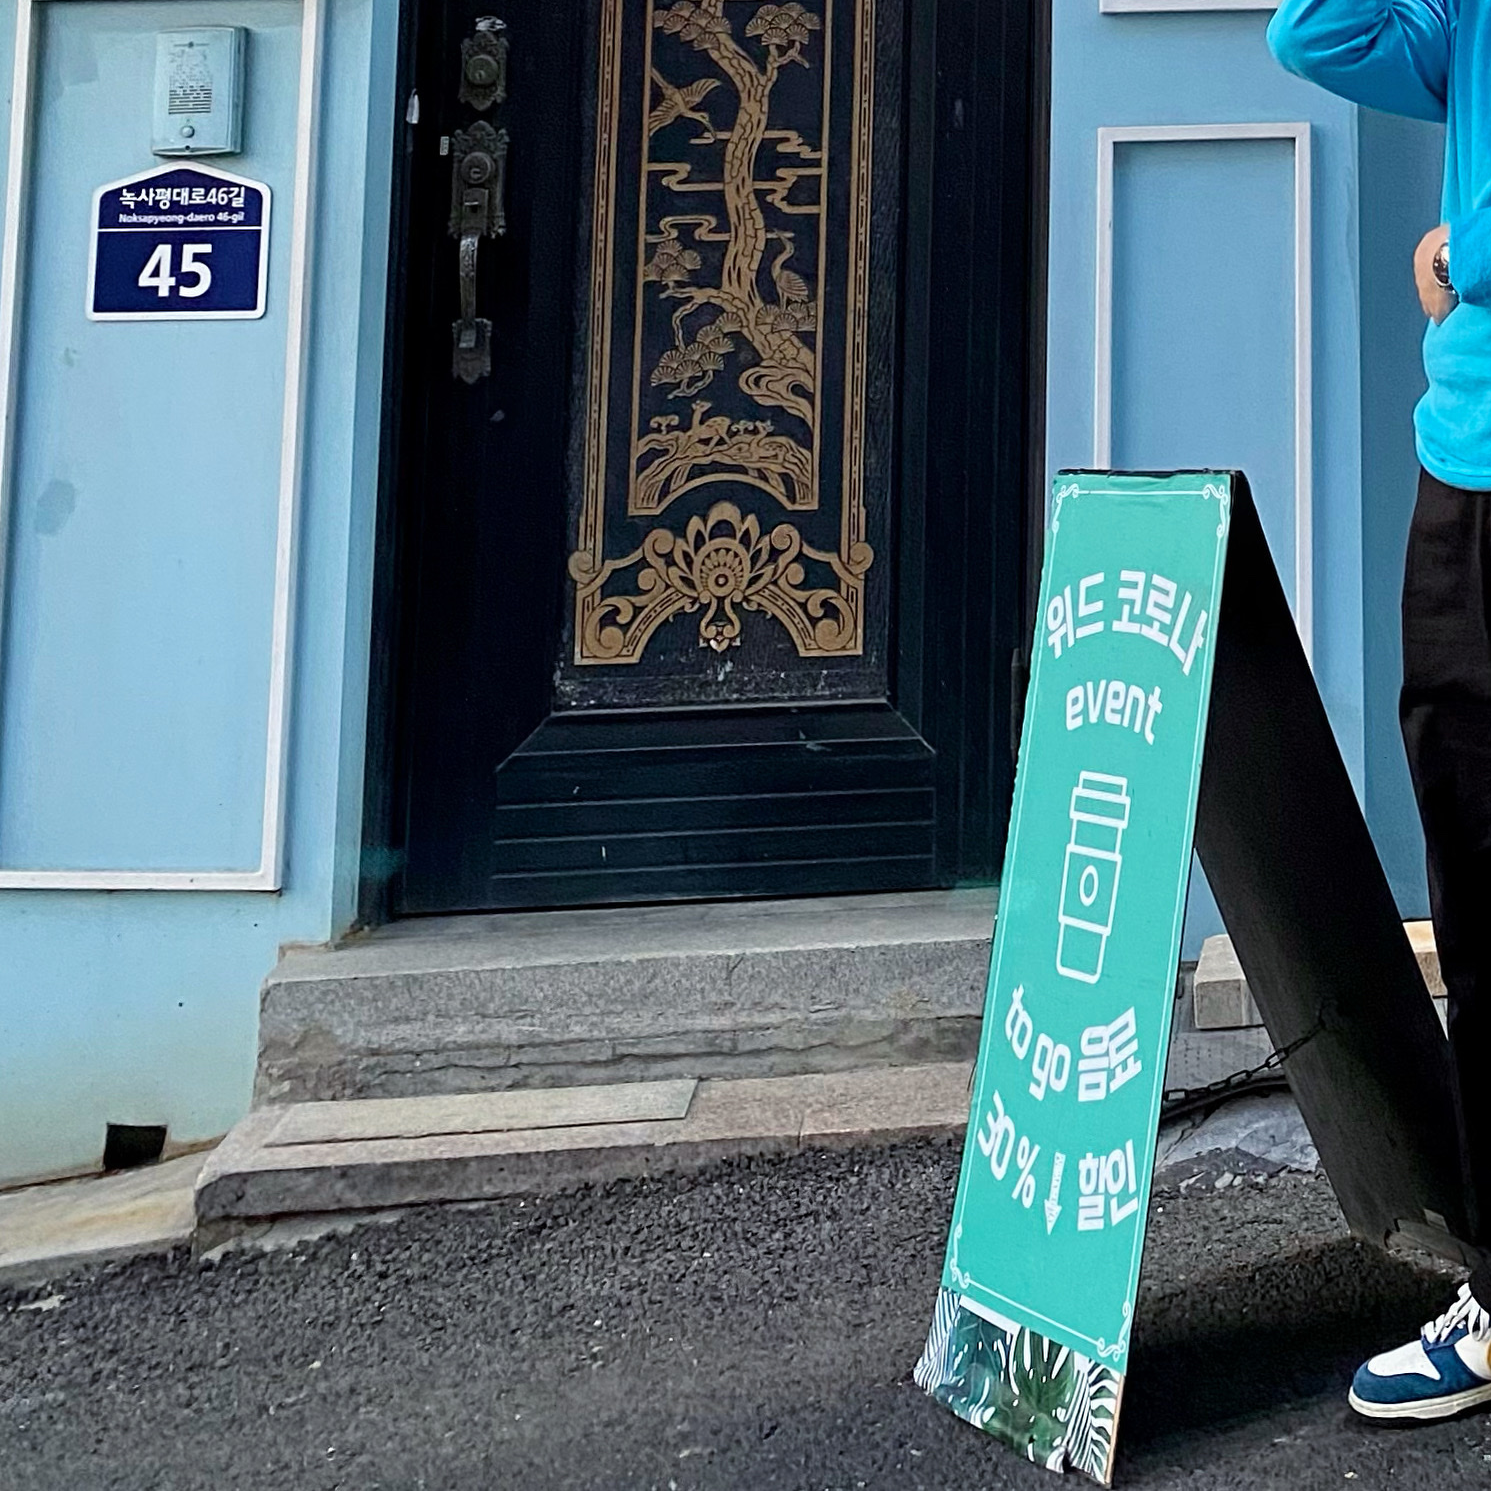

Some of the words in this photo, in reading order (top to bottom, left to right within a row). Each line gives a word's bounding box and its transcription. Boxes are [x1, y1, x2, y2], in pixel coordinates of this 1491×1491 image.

[118, 213, 215, 225] Noksapyeong-daero
[216, 211, 245, 224] 46-gil
[119, 186, 245, 210] 녹사평대로46길
[137, 243, 213, 298] 45
[1046, 571, 1105, 659] 위드
[1111, 569, 1209, 676] 코로나
[1065, 678, 1163, 745] event
[1005, 984, 1033, 1060] to
[1029, 1031, 1072, 1101] go
[1077, 1006, 1142, 1103] 음료
[977, 1089, 1017, 1181] 30
[1011, 1134, 1041, 1209] %
[1077, 1138, 1140, 1232] 할인
